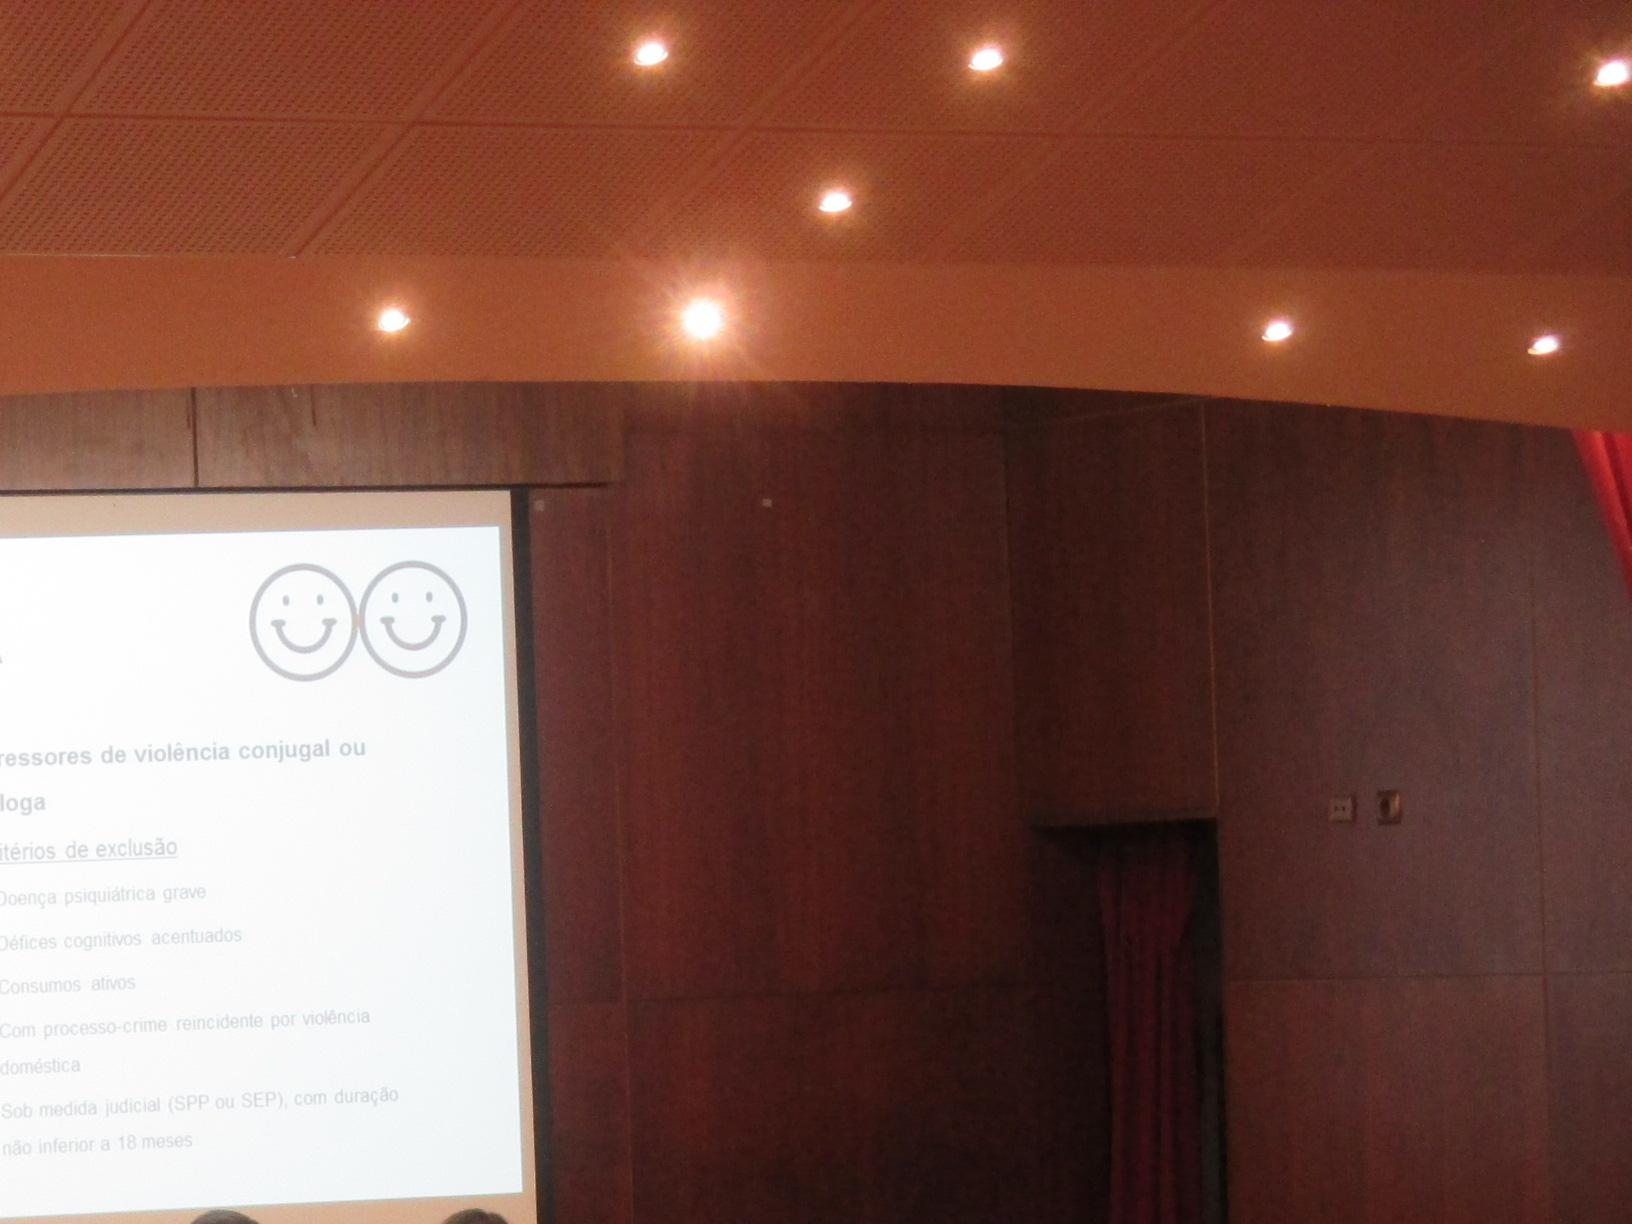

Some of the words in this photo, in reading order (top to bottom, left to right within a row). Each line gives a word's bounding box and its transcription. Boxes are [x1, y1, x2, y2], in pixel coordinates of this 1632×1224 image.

[101, 745, 126, 764] de
[134, 742, 230, 763] violência
[239, 739, 330, 763] conjugal
[339, 742, 366, 756] ou
[63, 841, 91, 861] de
[96, 837, 178, 859] exclusão
[65, 886, 155, 907] psiquiátrica
[163, 887, 206, 903] grave
[64, 932, 142, 951] cognitivos
[151, 928, 242, 945] acentuados
[91, 975, 136, 991] ativos
[0, 1023, 36, 1039] Com
[43, 1017, 168, 1040] processo-crime
[176, 1013, 263, 1031] reincidente
[271, 1014, 297, 1030] por
[302, 1009, 370, 1025] violência
[0, 1057, 80, 1075] doméstica
[1, 1102, 33, 1119] Sob
[40, 1100, 97, 1117] medida
[106, 1097, 160, 1117] judicial
[168, 1094, 209, 1114] (SPP
[215, 1097, 235, 1109] ou
[242, 1091, 287, 1110] SEP),
[294, 1093, 327, 1106] com
[334, 1087, 399, 1107] duração
[2, 1140, 32, 1156] não
[39, 1137, 95, 1154] inferior
[101, 1139, 110, 1151] a
[118, 1134, 137, 1150] 18
[142, 1135, 192, 1149] meses
